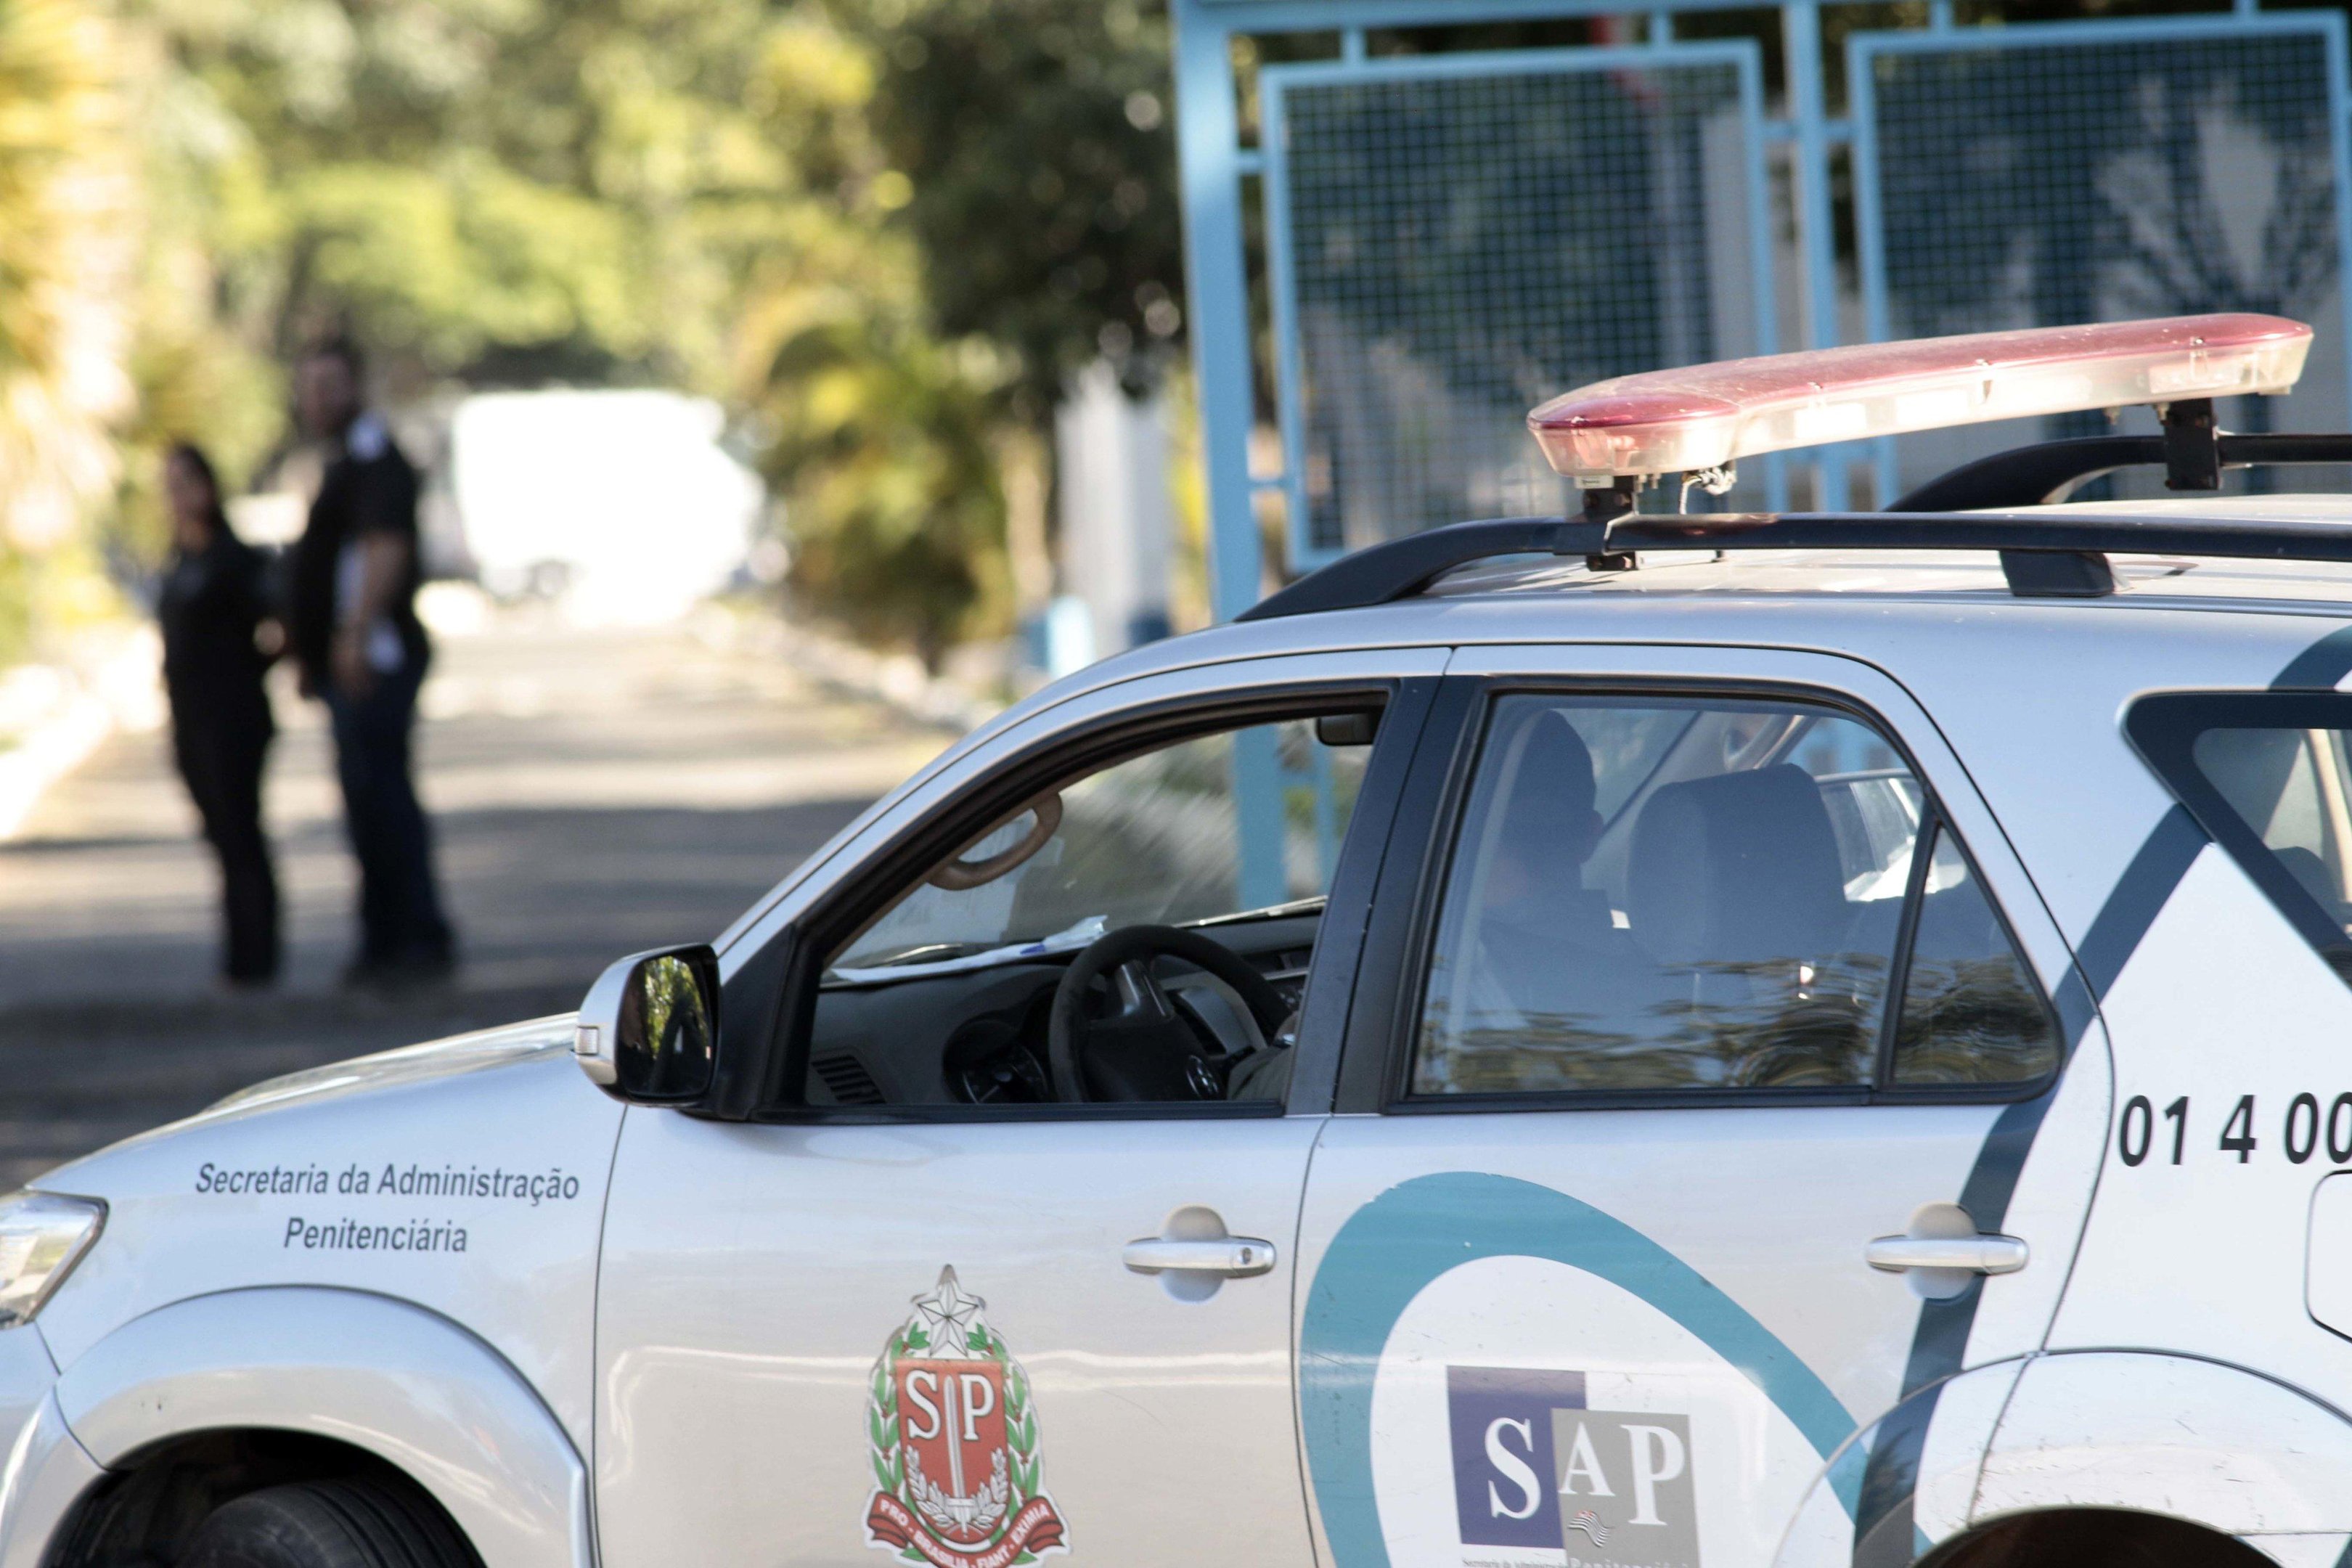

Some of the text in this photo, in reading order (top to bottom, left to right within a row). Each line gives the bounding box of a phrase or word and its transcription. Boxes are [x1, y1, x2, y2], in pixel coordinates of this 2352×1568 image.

[2118, 1091, 2352, 1167] 01 4 00
[195, 1162, 579, 1206] Secretaria da Administração
[283, 1217, 467, 1253] Penitenciária
[1484, 1417, 1685, 1526] SAP
